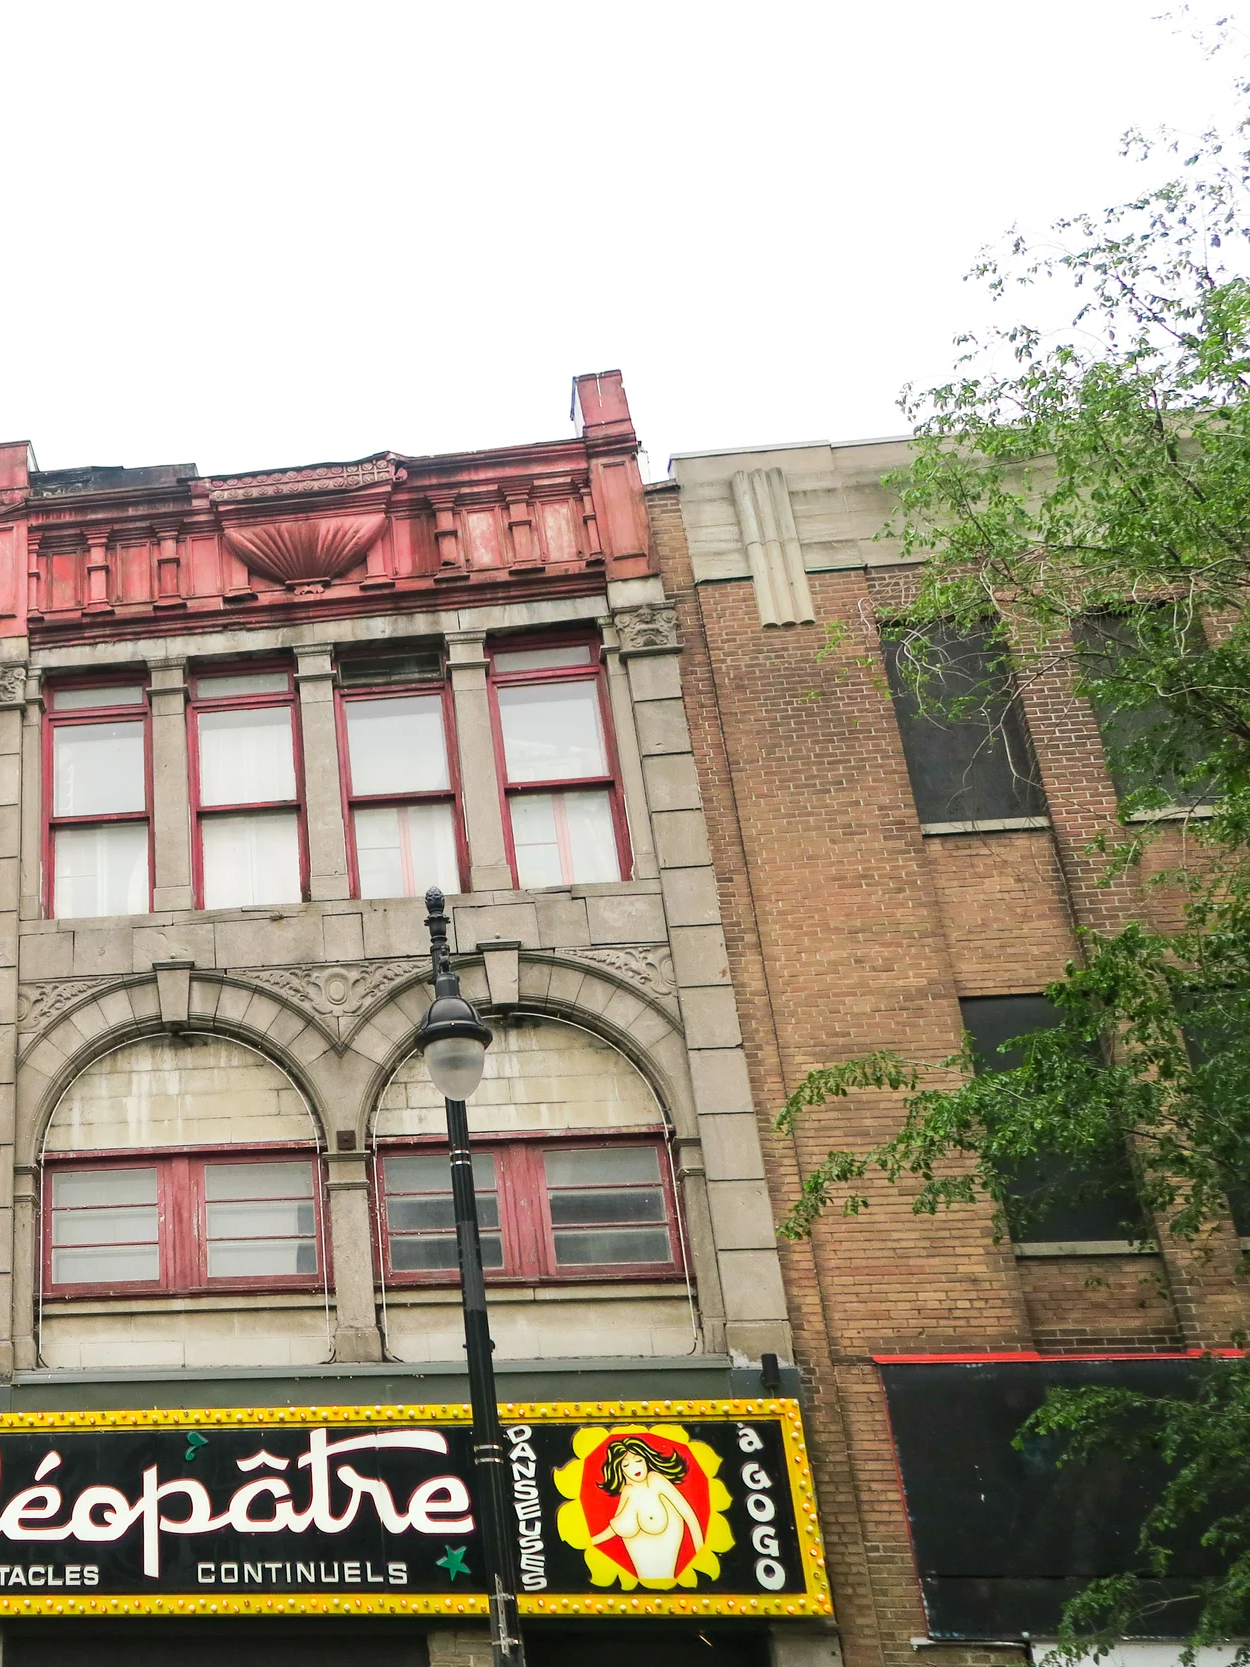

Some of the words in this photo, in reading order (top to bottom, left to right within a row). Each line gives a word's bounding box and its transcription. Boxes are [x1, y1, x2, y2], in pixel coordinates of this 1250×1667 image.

[505, 1423, 549, 1592] DANSEUSES
[740, 1462, 787, 1592] GOGO
[197, 1561, 409, 1585] CONTINUELS
